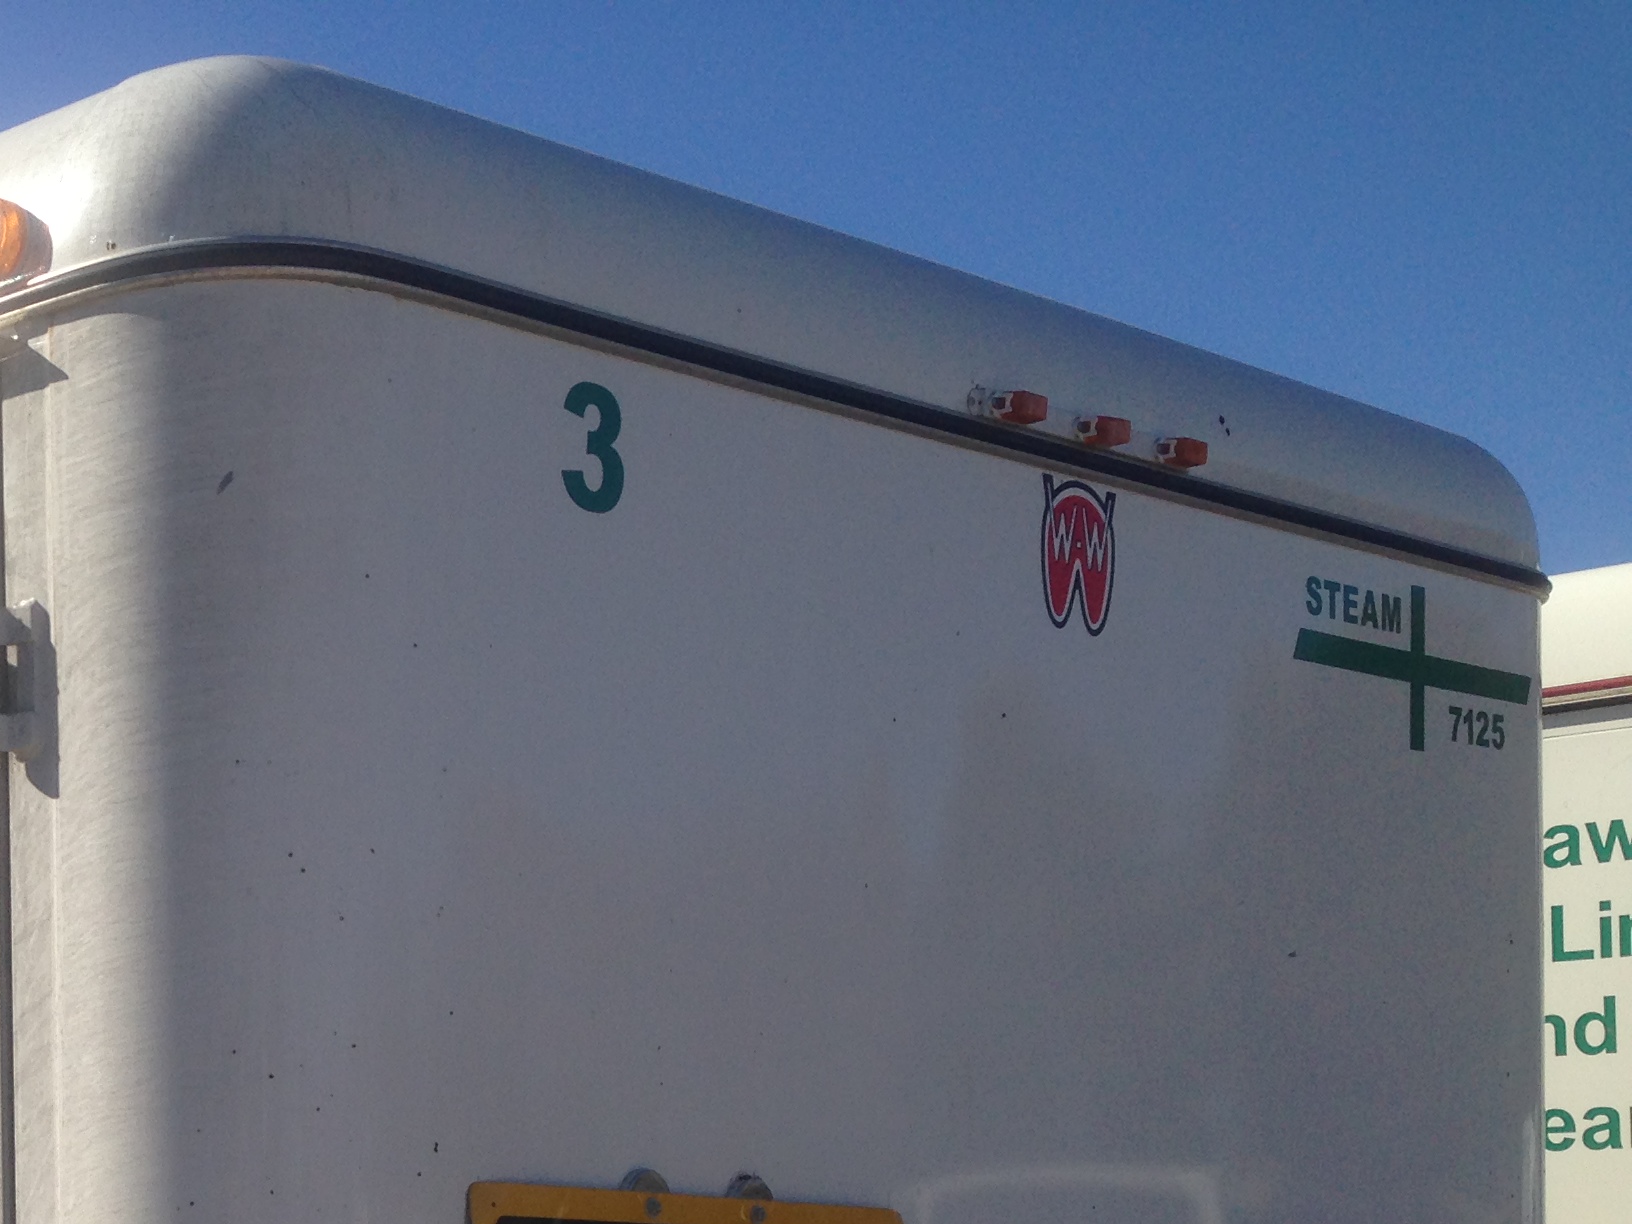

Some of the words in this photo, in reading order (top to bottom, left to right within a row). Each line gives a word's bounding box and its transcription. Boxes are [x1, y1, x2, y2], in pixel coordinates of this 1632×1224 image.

[561, 381, 624, 514] 3
[1305, 575, 1403, 635] STEAM
[1448, 706, 1506, 751] 7125
[1544, 1105, 1632, 1152] ea
